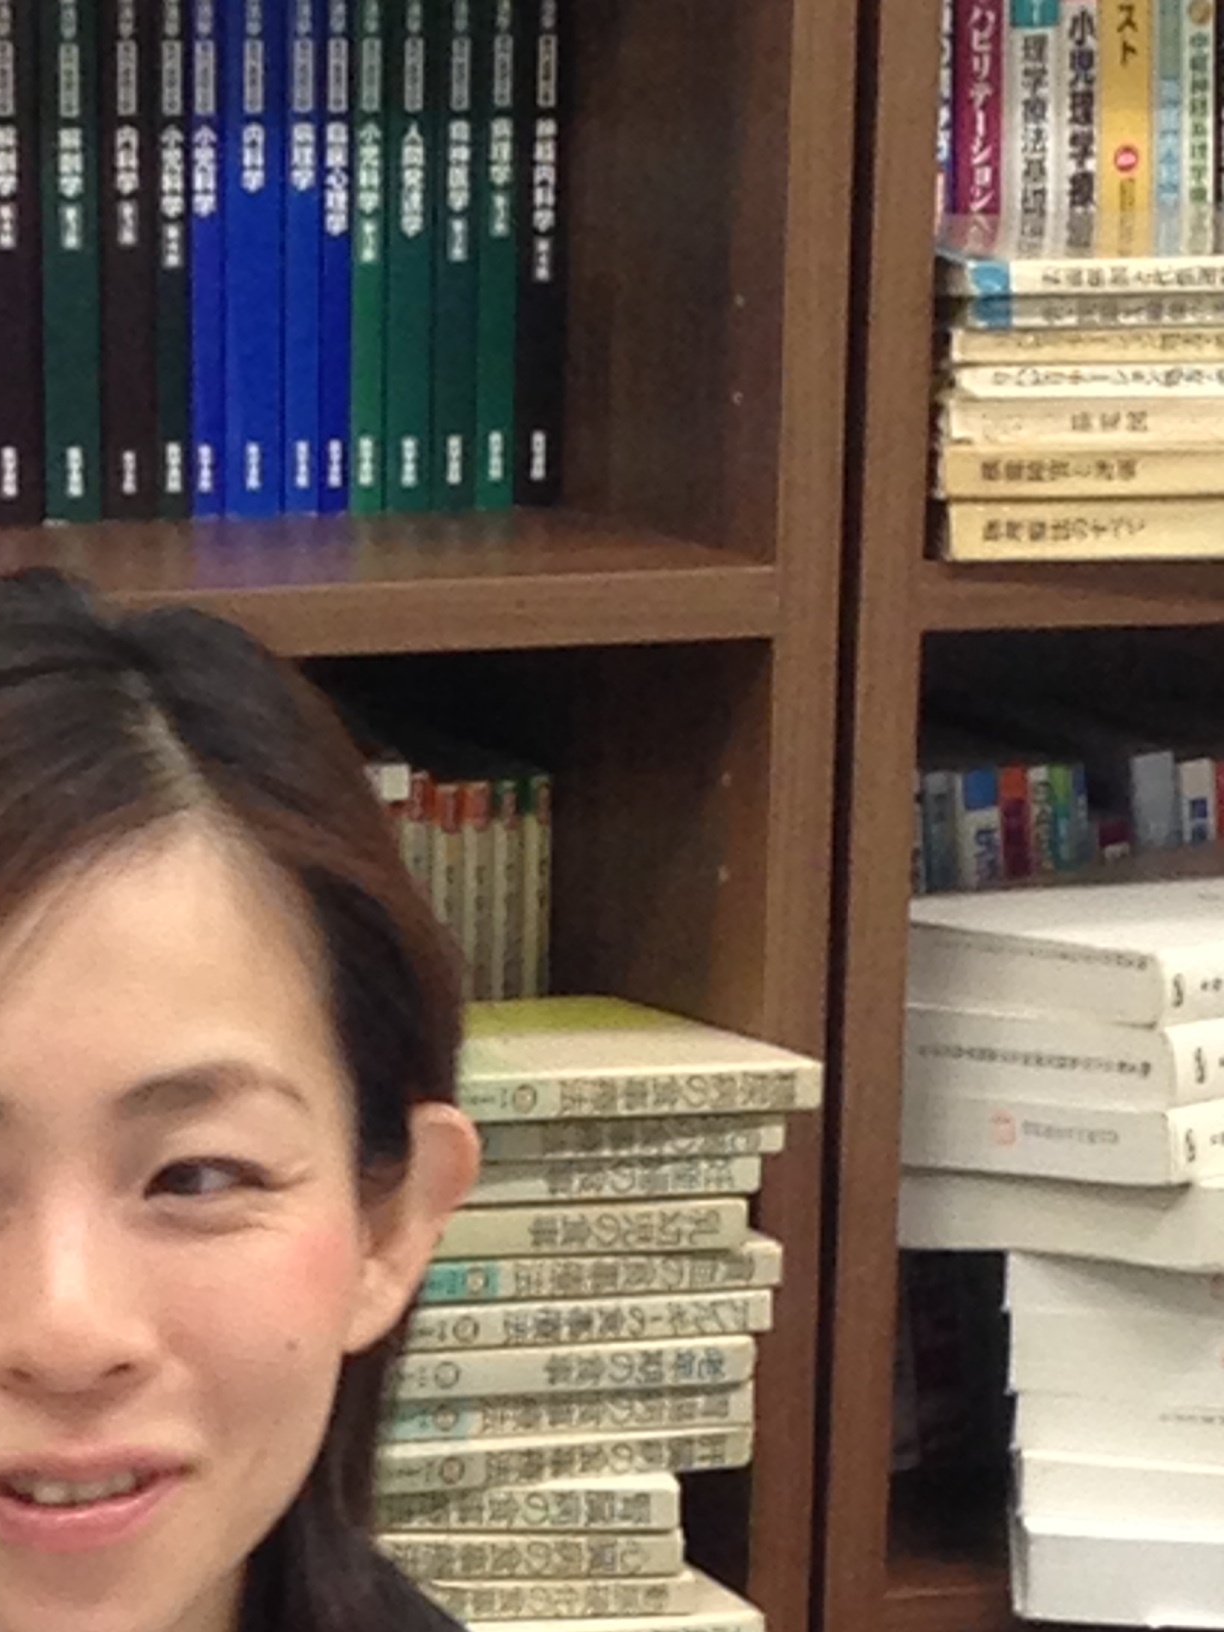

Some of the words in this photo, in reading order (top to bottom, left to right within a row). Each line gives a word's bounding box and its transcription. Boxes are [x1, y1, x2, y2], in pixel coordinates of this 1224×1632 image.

[529, 1207, 722, 1249] 乳幼児の食事
